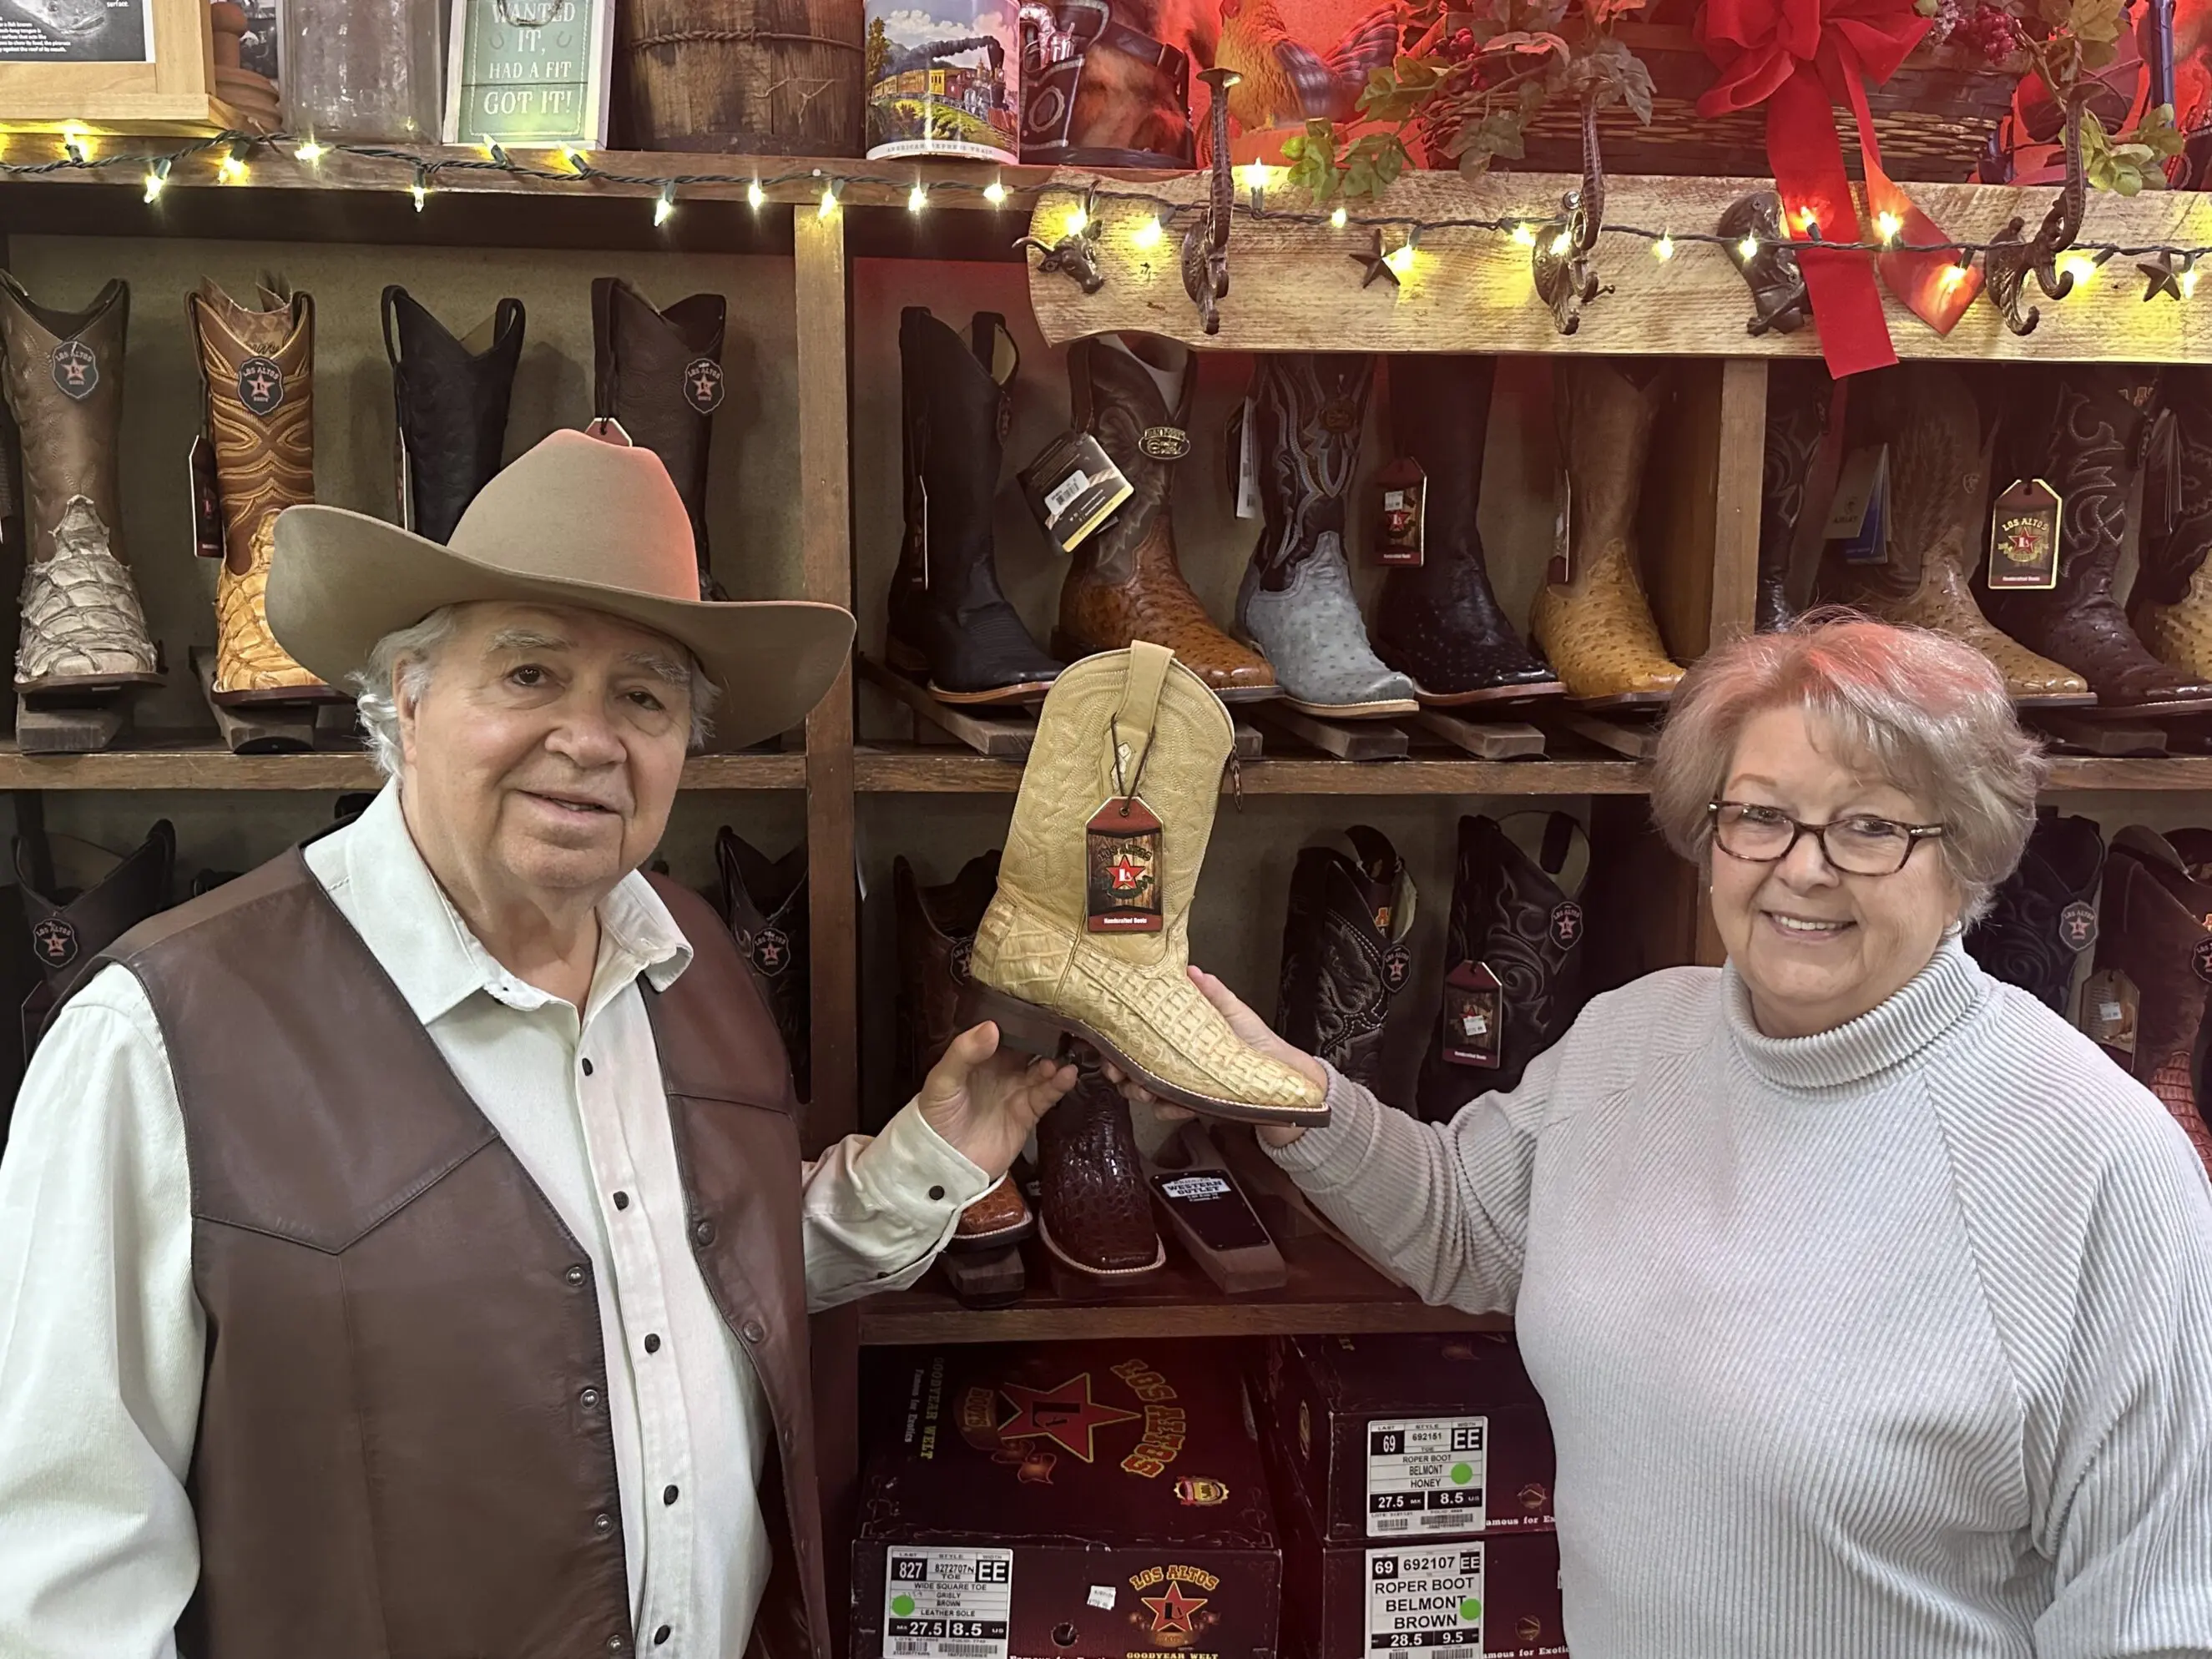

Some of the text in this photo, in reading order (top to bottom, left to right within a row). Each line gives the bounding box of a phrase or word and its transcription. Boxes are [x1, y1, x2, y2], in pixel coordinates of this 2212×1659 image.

[518, 29, 546, 55] IT,
[489, 61, 572, 78] HAD A FIT
[484, 90, 572, 114] GOT IT!
[2002, 517, 2048, 532] LOS ALTOS
[1167, 1180, 1222, 1191] WESTERN
[1177, 1186, 1220, 1194] OUTLET
[905, 1369, 924, 1442] Famous for Exotics
[921, 1357, 944, 1459] GOODYEAR WELT
[1109, 1359, 1186, 1478] LOS ALTOS
[1383, 1435, 1396, 1453] 69
[1454, 1428, 1480, 1450] EE
[1431, 1454, 1452, 1462] BOOT
[1409, 1465, 1443, 1475] BELMONT
[1410, 1479, 1442, 1488] HONEY
[1378, 1495, 1404, 1509] 27.5
[1440, 1492, 1464, 1505] 8.5
[1486, 1517, 1519, 1526] amous
[1523, 1515, 1538, 1525] for
[899, 1561, 1006, 1581] 827 8272707N EE
[1375, 1556, 1480, 1574] 69 692107 EE
[1129, 1565, 1220, 1591] LOS ALTOS
[1375, 1577, 1474, 1594] ROPER BOOT
[909, 1621, 942, 1636] 27.5
[952, 1622, 982, 1636] 8.5
[1394, 1614, 1457, 1629] BROWN
[1391, 1631, 1463, 1647] 28.5 9.5
[1484, 1651, 1514, 1659] amous
[1519, 1648, 1534, 1656] for
